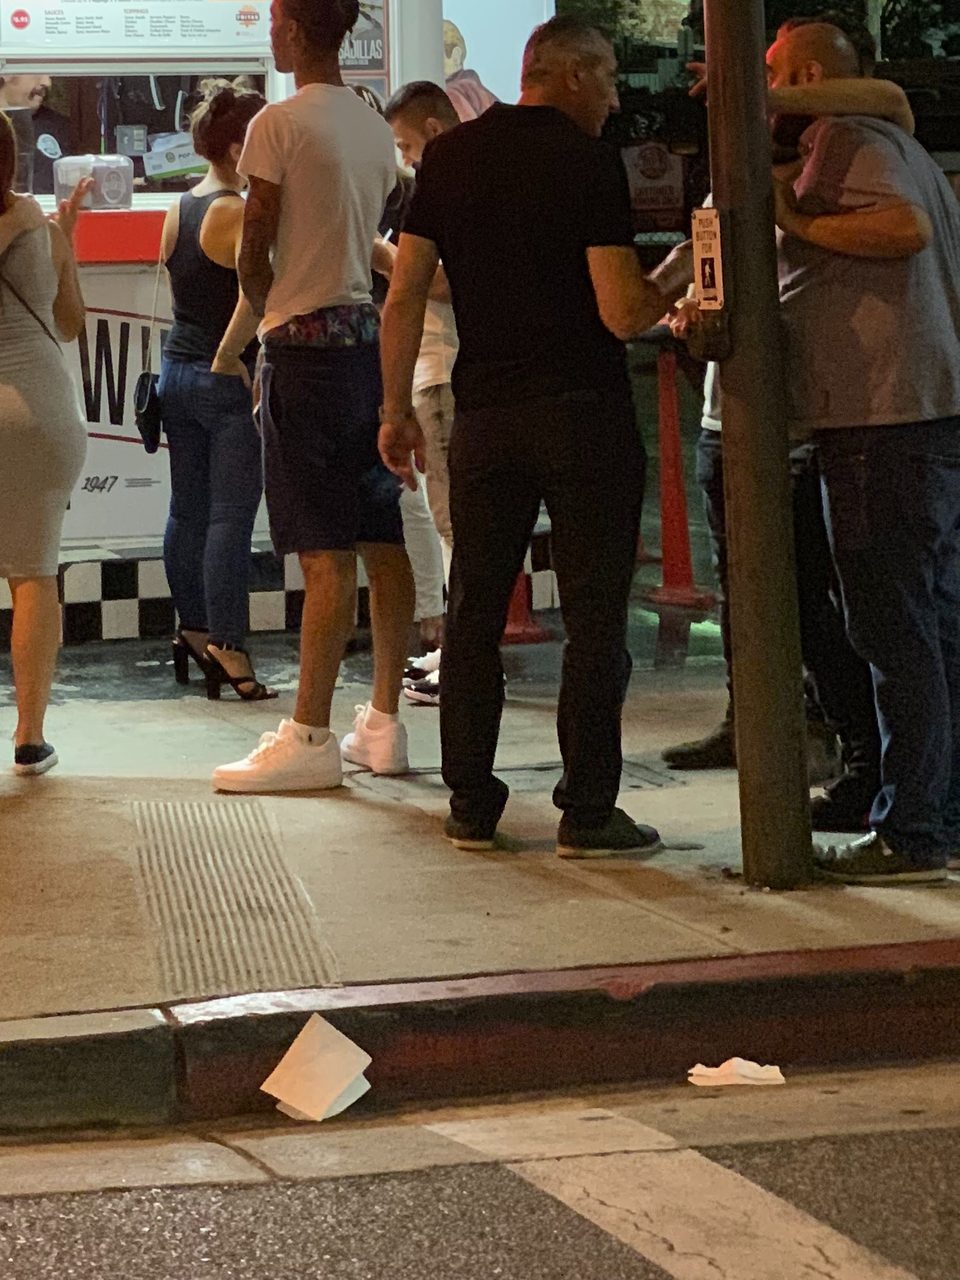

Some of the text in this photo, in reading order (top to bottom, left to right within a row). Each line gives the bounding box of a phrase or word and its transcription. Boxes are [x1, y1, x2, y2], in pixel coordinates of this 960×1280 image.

[338, 39, 383, 60] SADILLAS
[698, 217, 714, 229] PUSH
[695, 230, 718, 242] BUTTON
[701, 242, 713, 254] FOR
[81, 475, 120, 493] 1947
